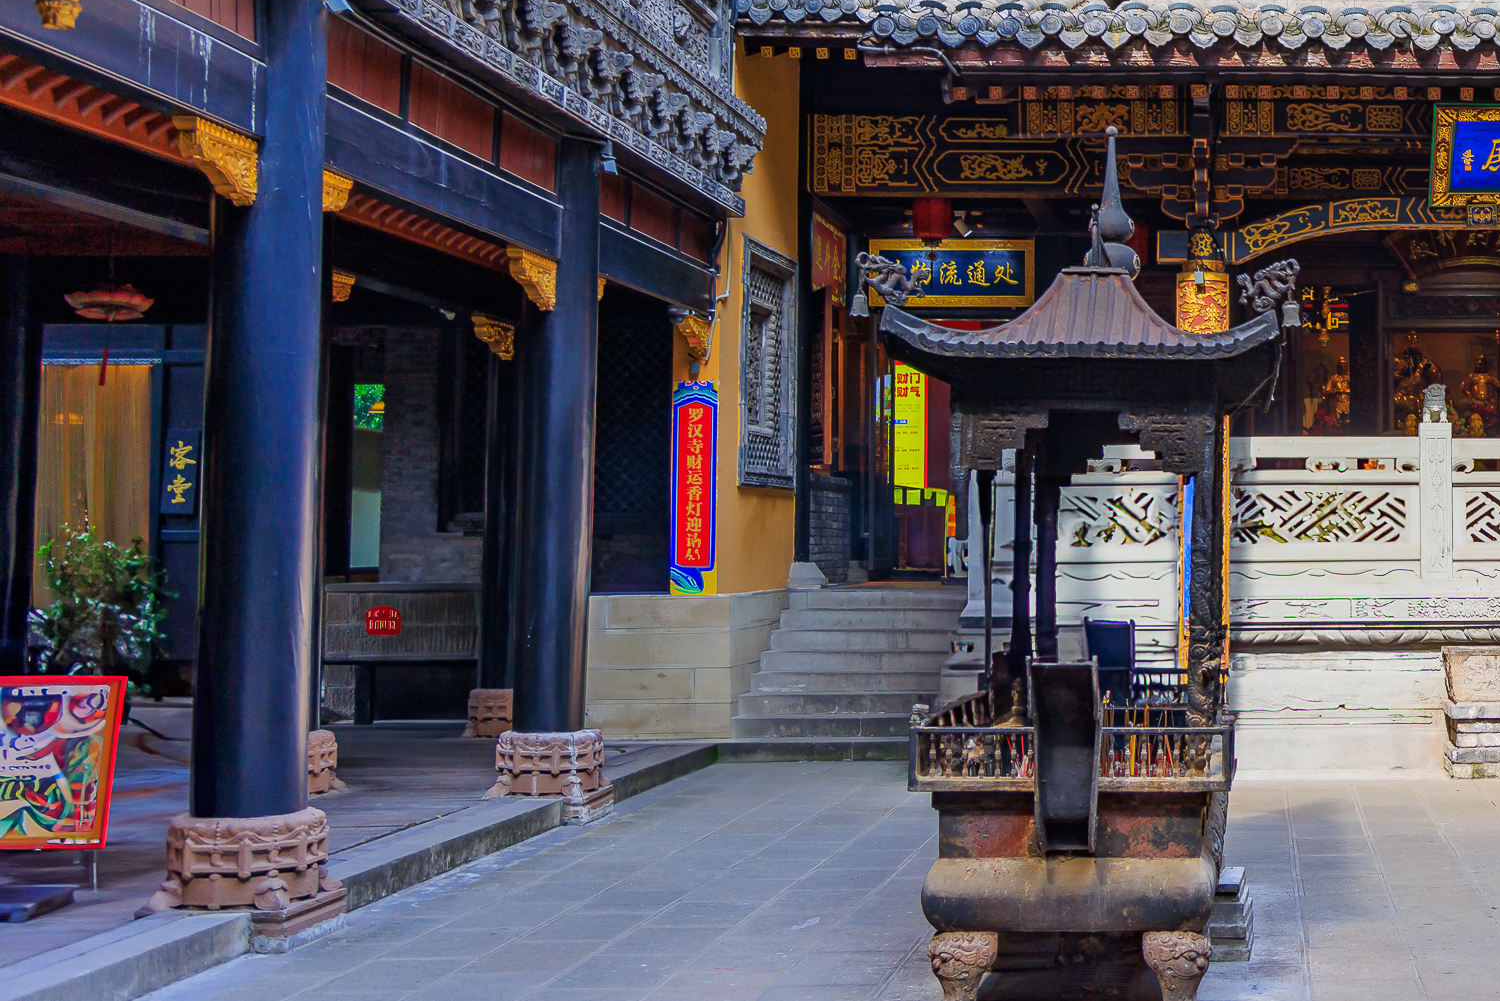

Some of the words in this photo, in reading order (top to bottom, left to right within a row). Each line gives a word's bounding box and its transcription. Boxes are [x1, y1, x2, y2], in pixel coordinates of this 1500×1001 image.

[888, 259, 1019, 287] 物流通处
[895, 373, 921, 385] 财门
[895, 386, 921, 398] 财气
